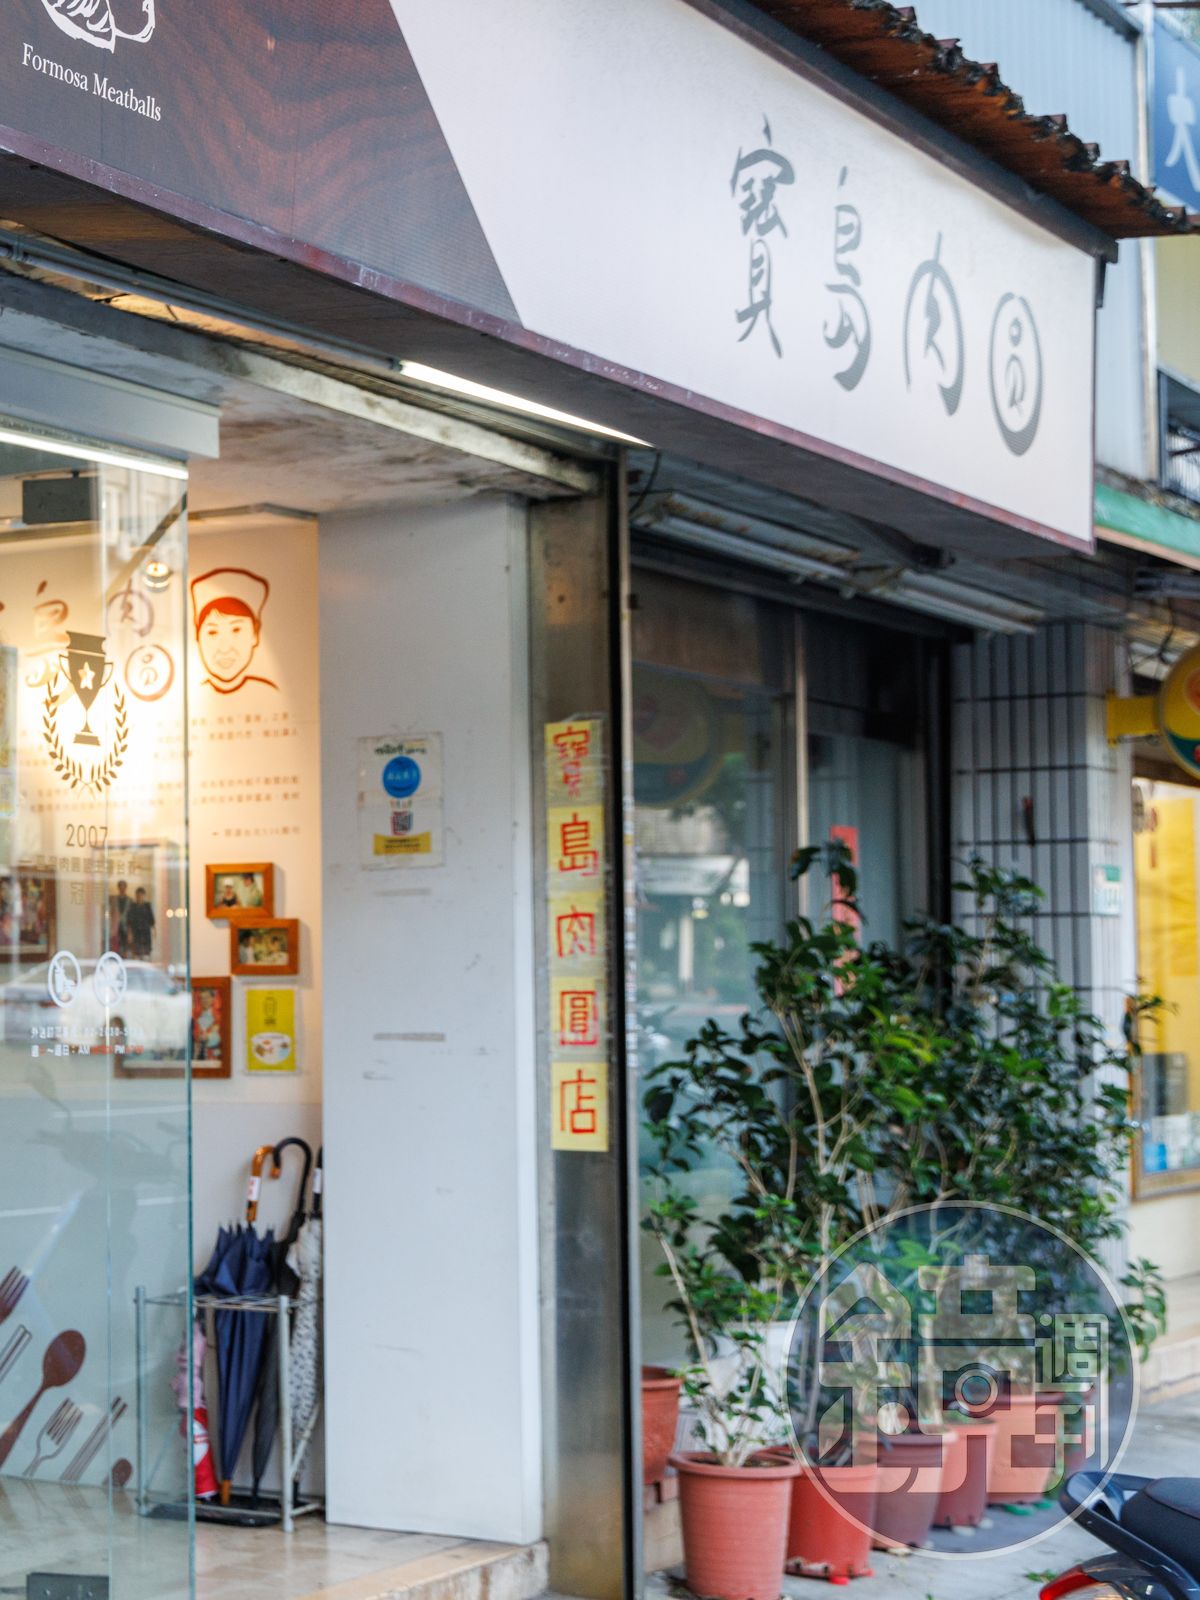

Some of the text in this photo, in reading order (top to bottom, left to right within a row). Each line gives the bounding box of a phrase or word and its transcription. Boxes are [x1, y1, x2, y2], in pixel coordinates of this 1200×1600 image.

[21, 42, 162, 122] Formosa Meatballs
[729, 112, 1042, 457] 寶島肉圓
[65, 823, 108, 849] 2007
